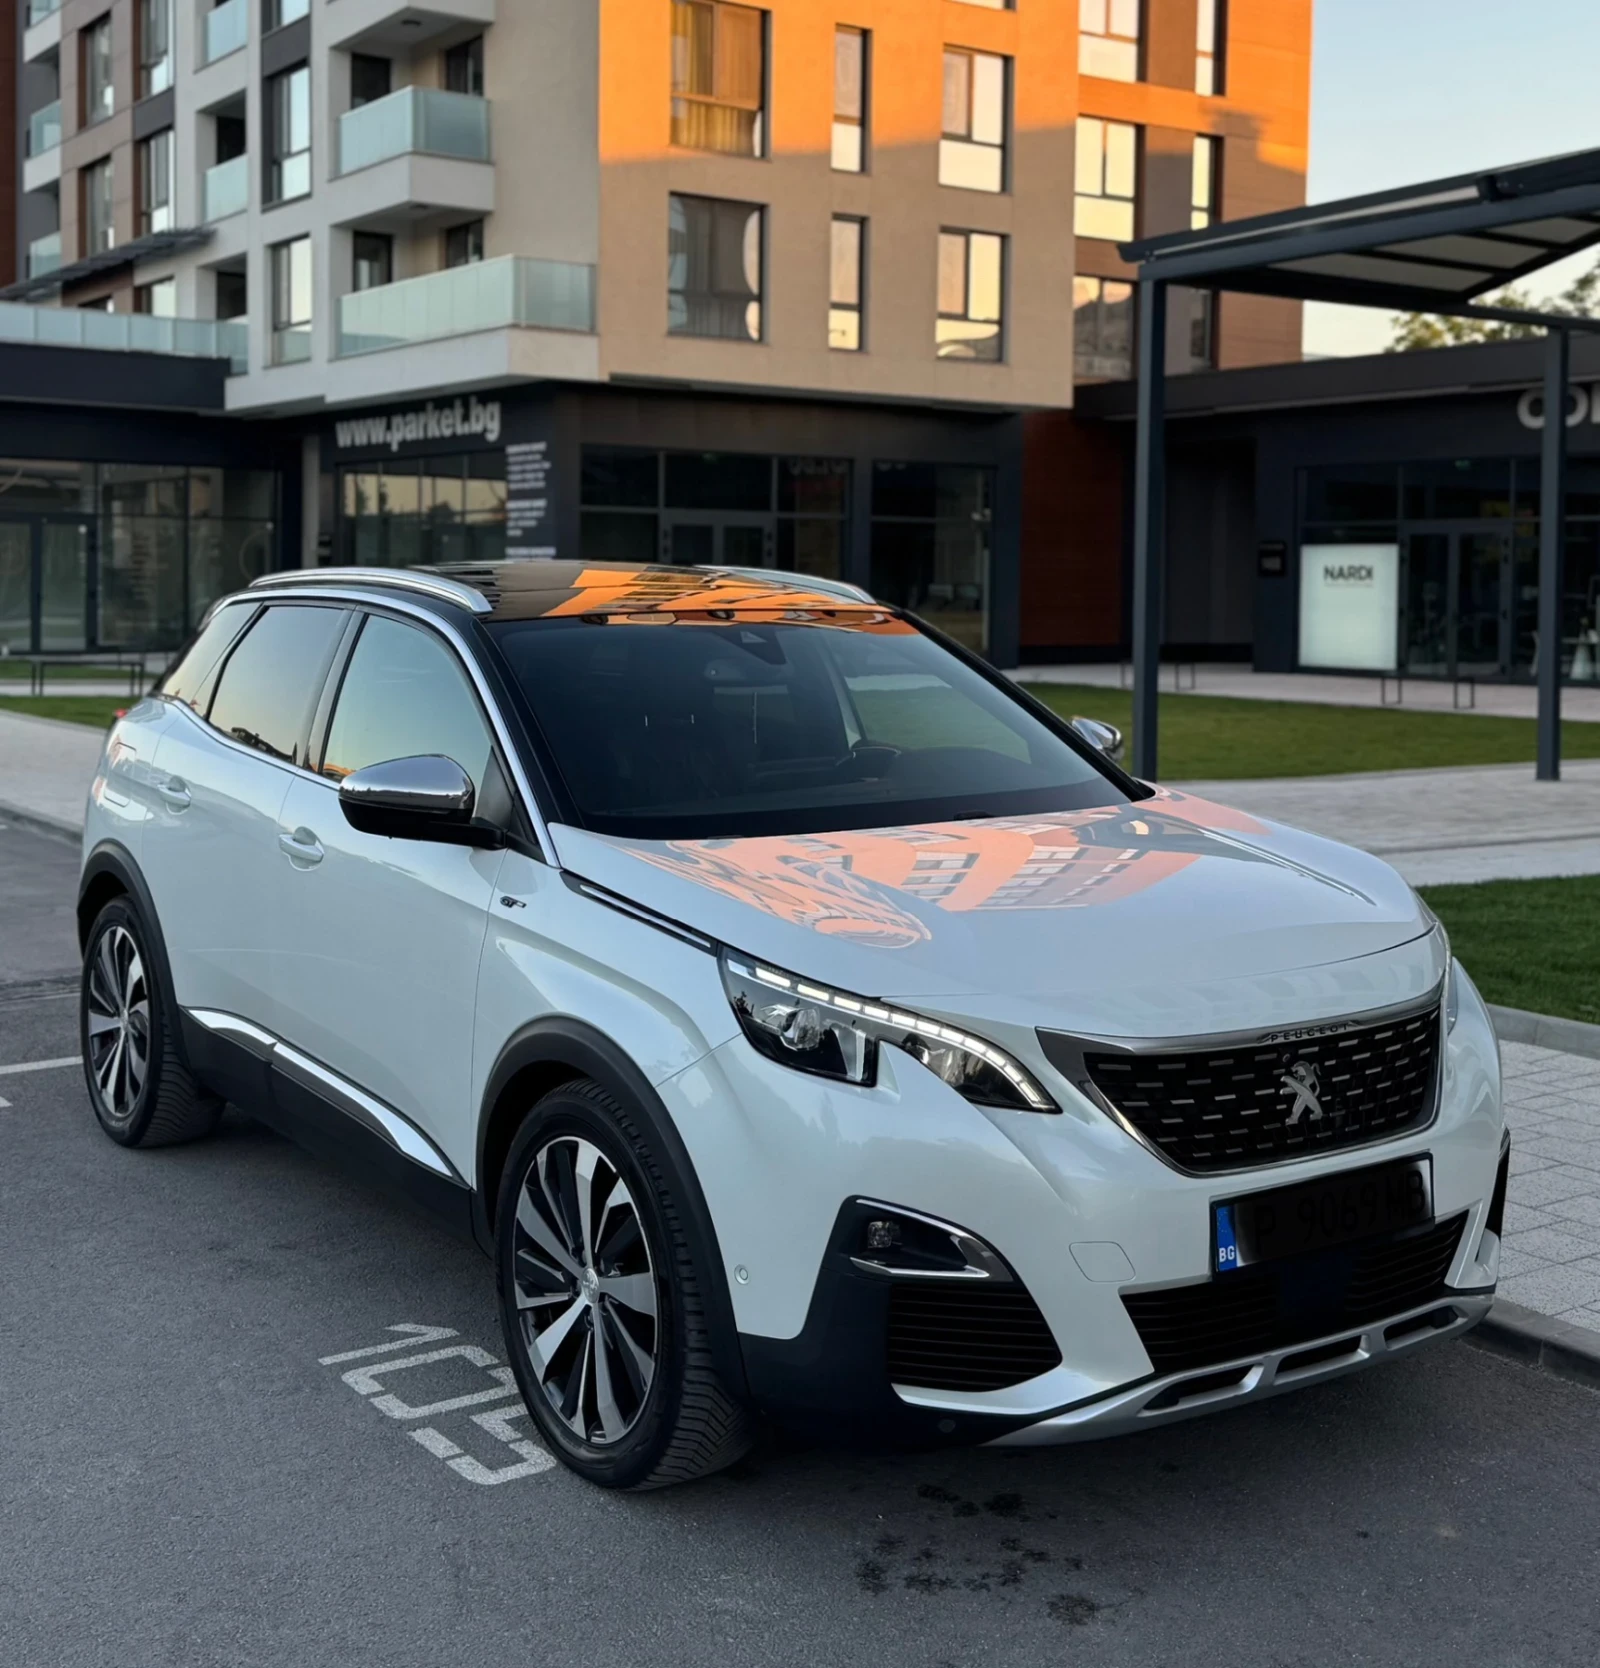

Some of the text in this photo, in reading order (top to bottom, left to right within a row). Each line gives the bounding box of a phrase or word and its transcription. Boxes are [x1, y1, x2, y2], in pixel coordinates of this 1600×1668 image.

[335, 396, 502, 452] www.parket.bg
[1323, 565, 1374, 581] NARDI
[1270, 1022, 1349, 1042] PEUGEOT
[1218, 1245, 1236, 1262] BG
[318, 1322, 557, 1485] 105
